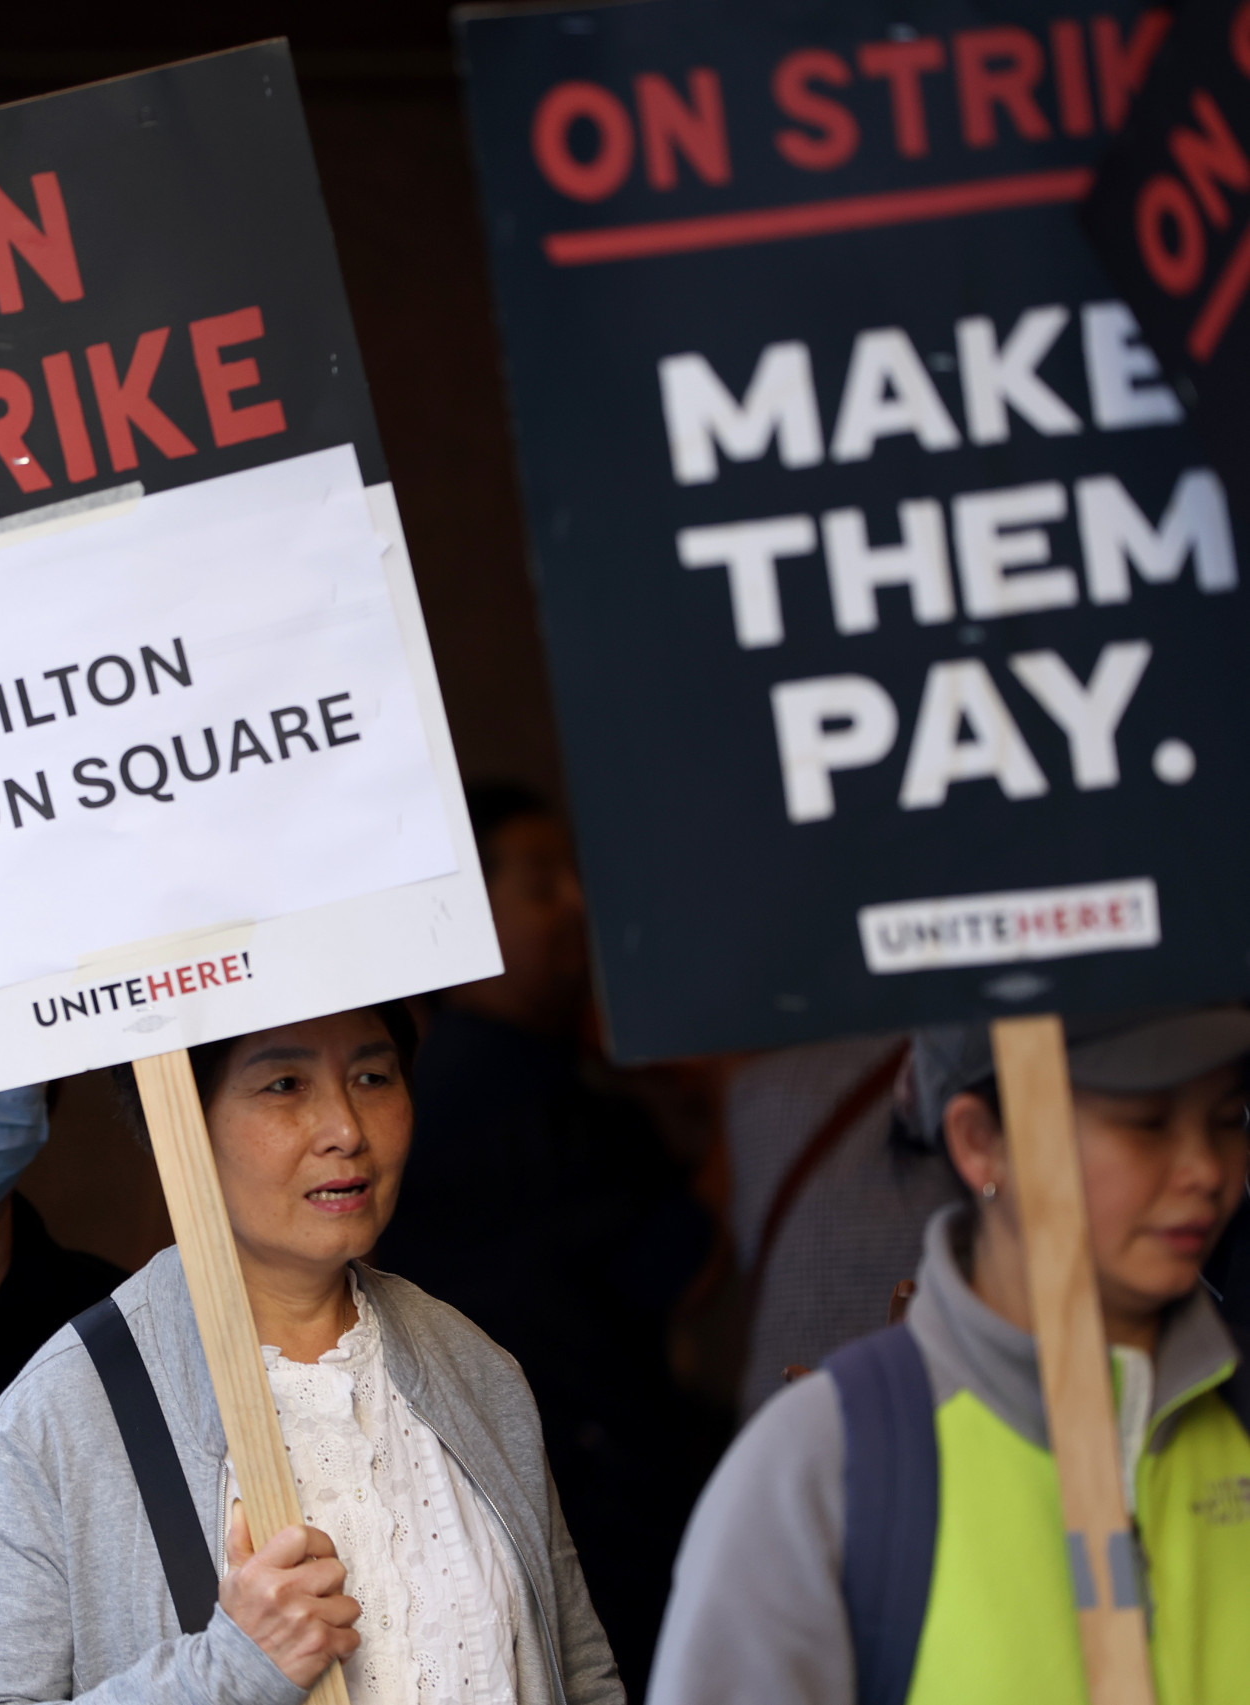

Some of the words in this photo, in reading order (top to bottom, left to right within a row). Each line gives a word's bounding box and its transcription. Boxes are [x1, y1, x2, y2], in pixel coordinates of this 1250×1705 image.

[531, 67, 732, 202] ON
[772, 9, 1173, 170] STRIK
[1134, 87, 1250, 297] ON
[658, 301, 1184, 484] MAKE
[677, 467, 1238, 650] THEM
[72, 692, 361, 808] SQUARE
[770, 640, 1196, 825] PAY.
